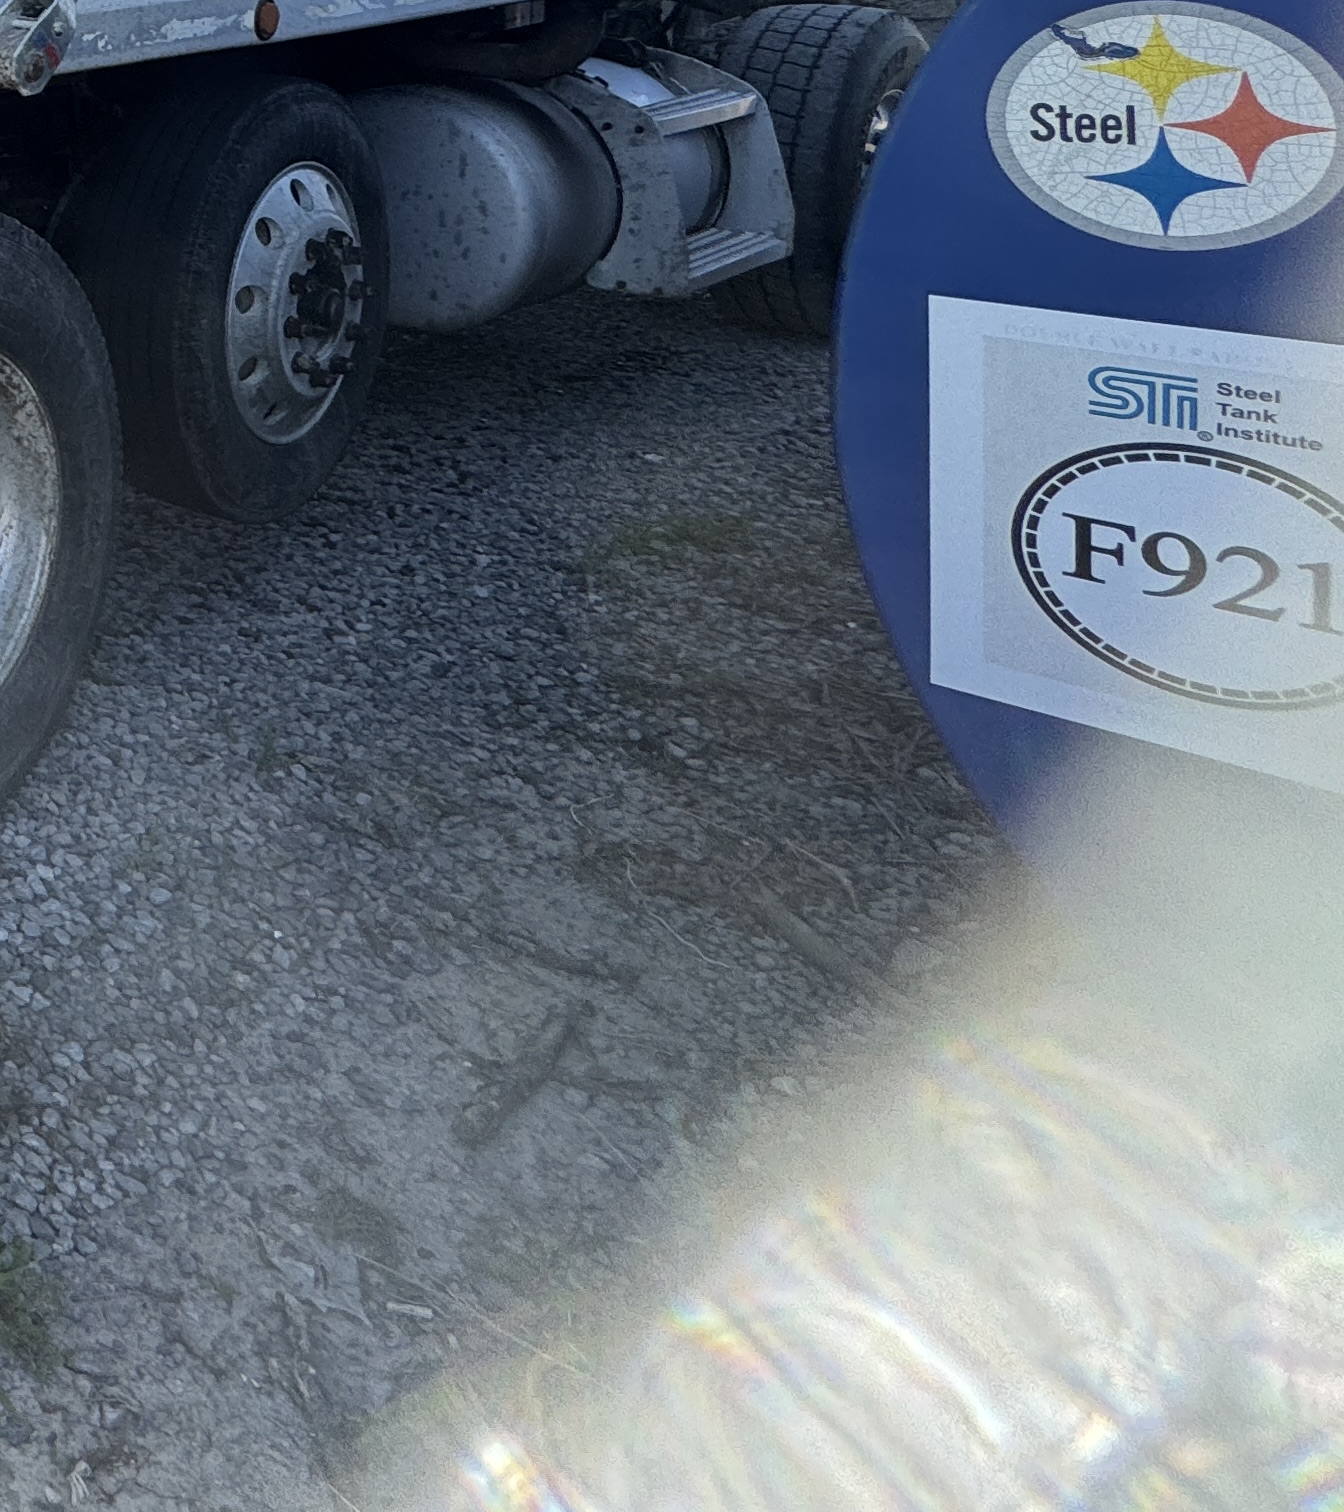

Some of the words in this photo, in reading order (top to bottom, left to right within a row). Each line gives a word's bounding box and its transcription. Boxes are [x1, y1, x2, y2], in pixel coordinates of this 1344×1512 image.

[1029, 102, 1137, 146] Steel
[1216, 382, 1282, 404] Steel
[1216, 402, 1279, 425] Tank
[1216, 423, 1324, 452] Institute
[1061, 511, 1344, 637] F921
